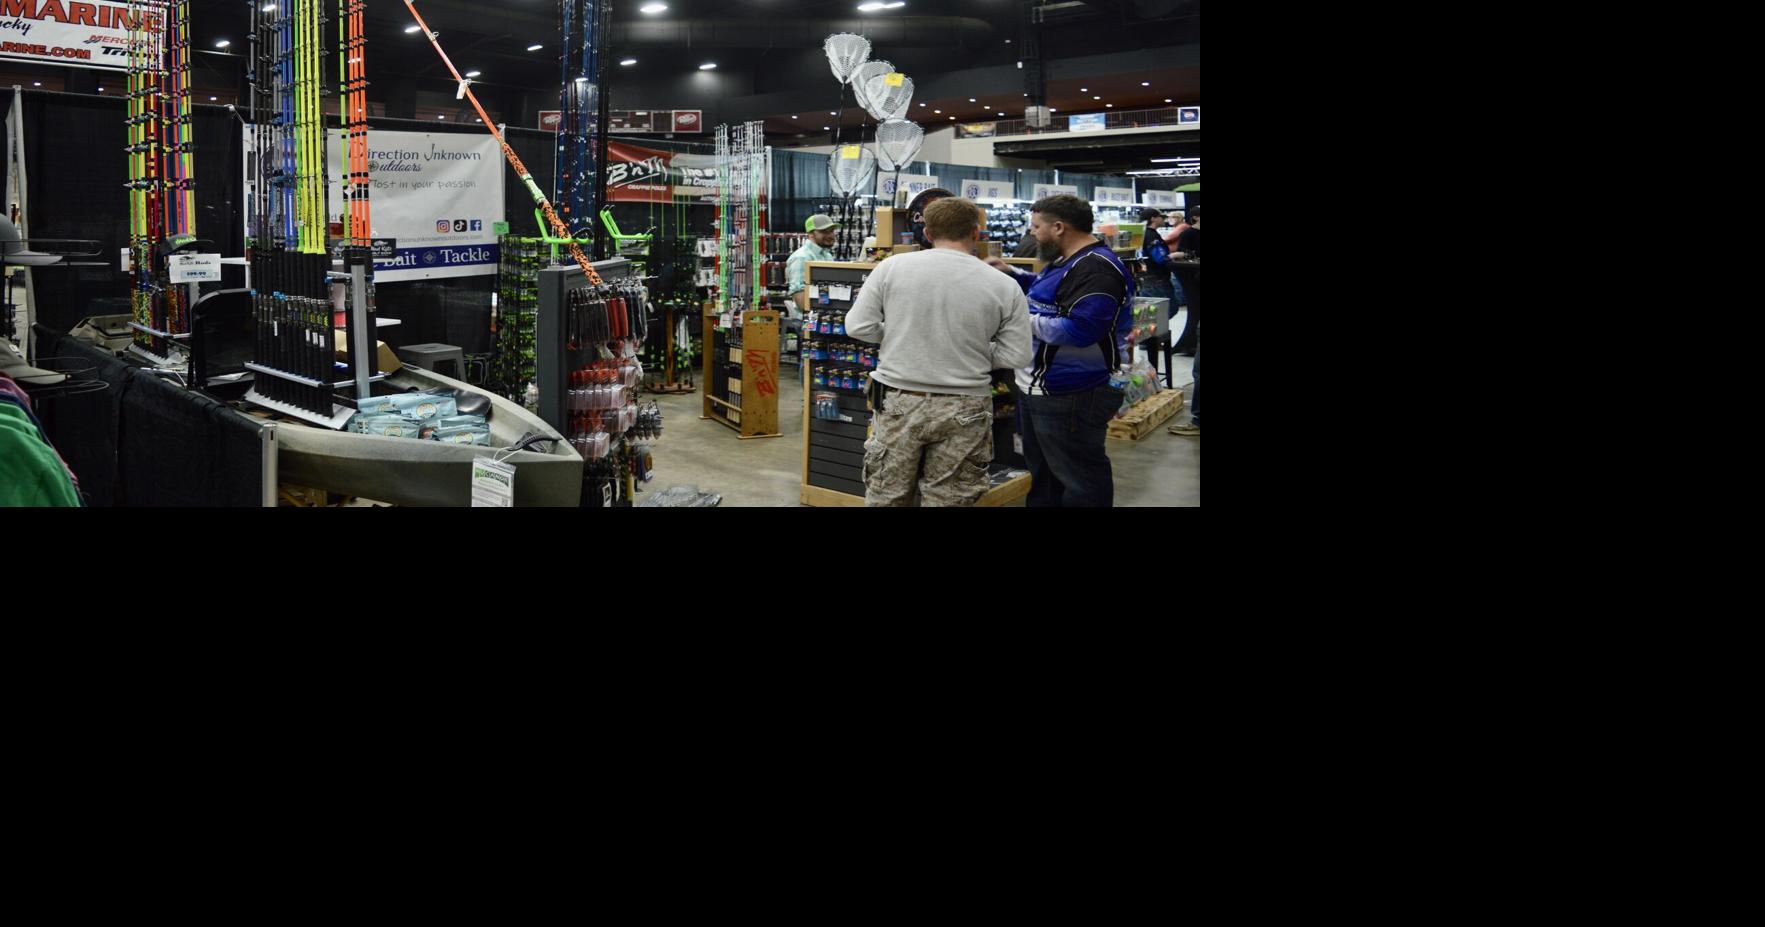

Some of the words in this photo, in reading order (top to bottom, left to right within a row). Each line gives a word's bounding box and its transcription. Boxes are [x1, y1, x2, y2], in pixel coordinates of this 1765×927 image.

[0, 41, 91, 60] RINE.COM
[400, 181, 408, 189] in
[411, 181, 434, 190] your
[438, 180, 476, 190] passion
[440, 248, 490, 263] Tackle
